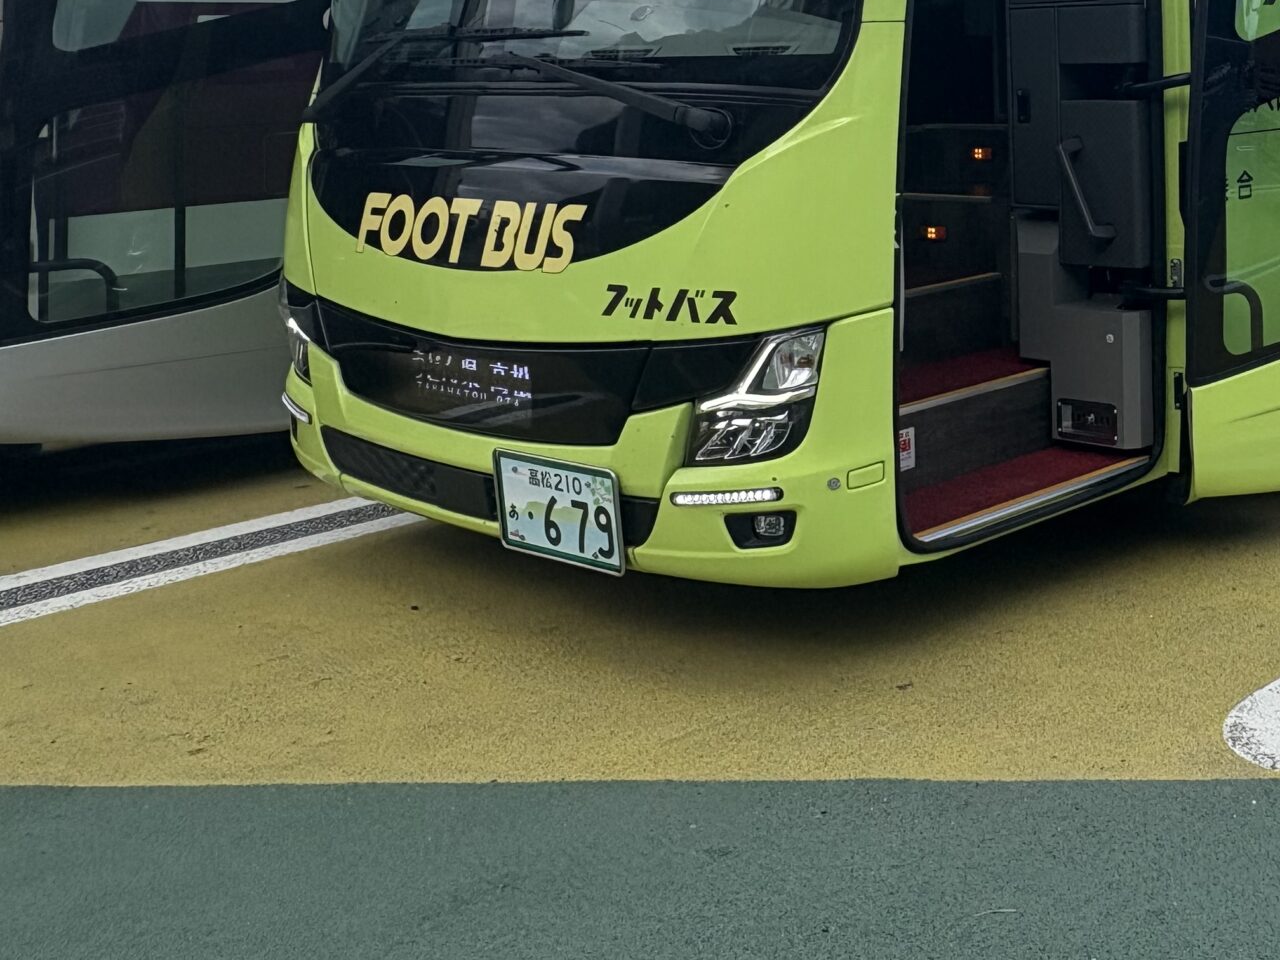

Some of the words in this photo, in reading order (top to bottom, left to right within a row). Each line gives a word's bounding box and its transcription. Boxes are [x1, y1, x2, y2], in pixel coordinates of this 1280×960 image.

[355, 191, 483, 264] FOOT
[480, 200, 588, 274] BUS
[601, 283, 738, 325] フットバス
